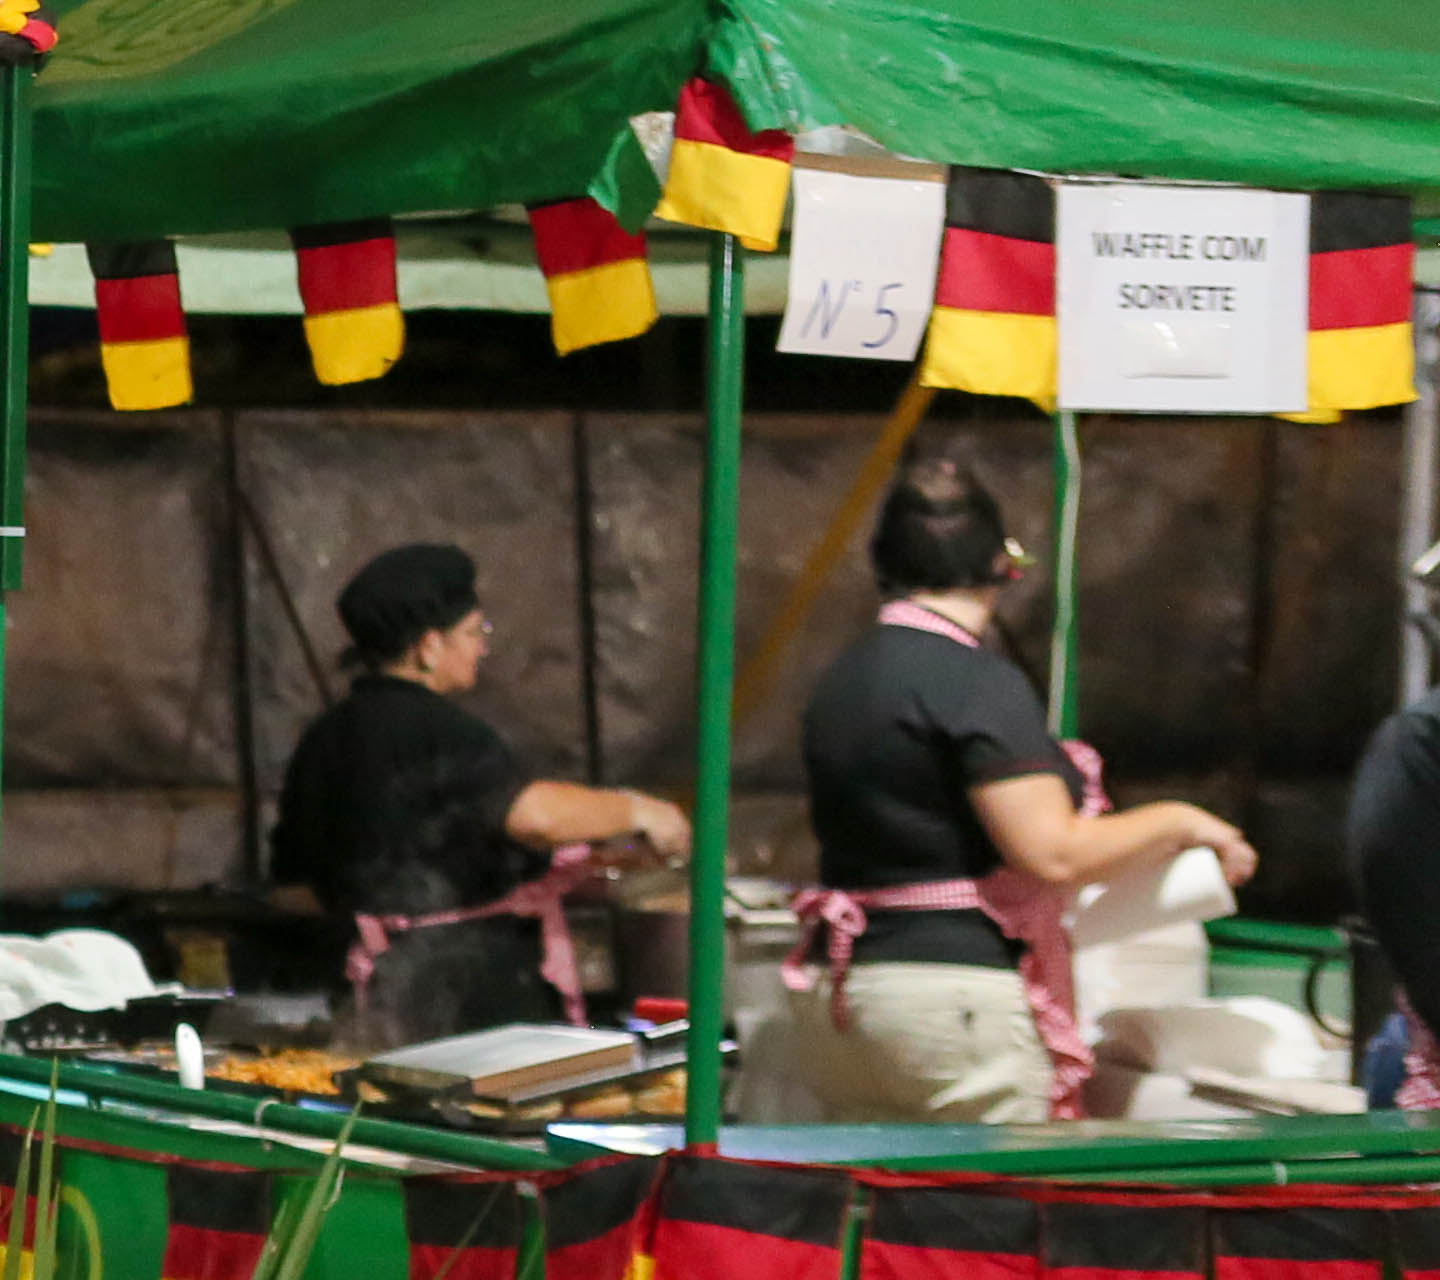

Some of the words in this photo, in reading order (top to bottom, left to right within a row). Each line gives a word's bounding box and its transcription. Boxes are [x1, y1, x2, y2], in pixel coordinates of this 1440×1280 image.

[1091, 232, 1194, 260] WAFFLE
[1201, 234, 1268, 262] COM
[1118, 282, 1237, 312] SORVETE
[860, 281, 905, 349] 5
